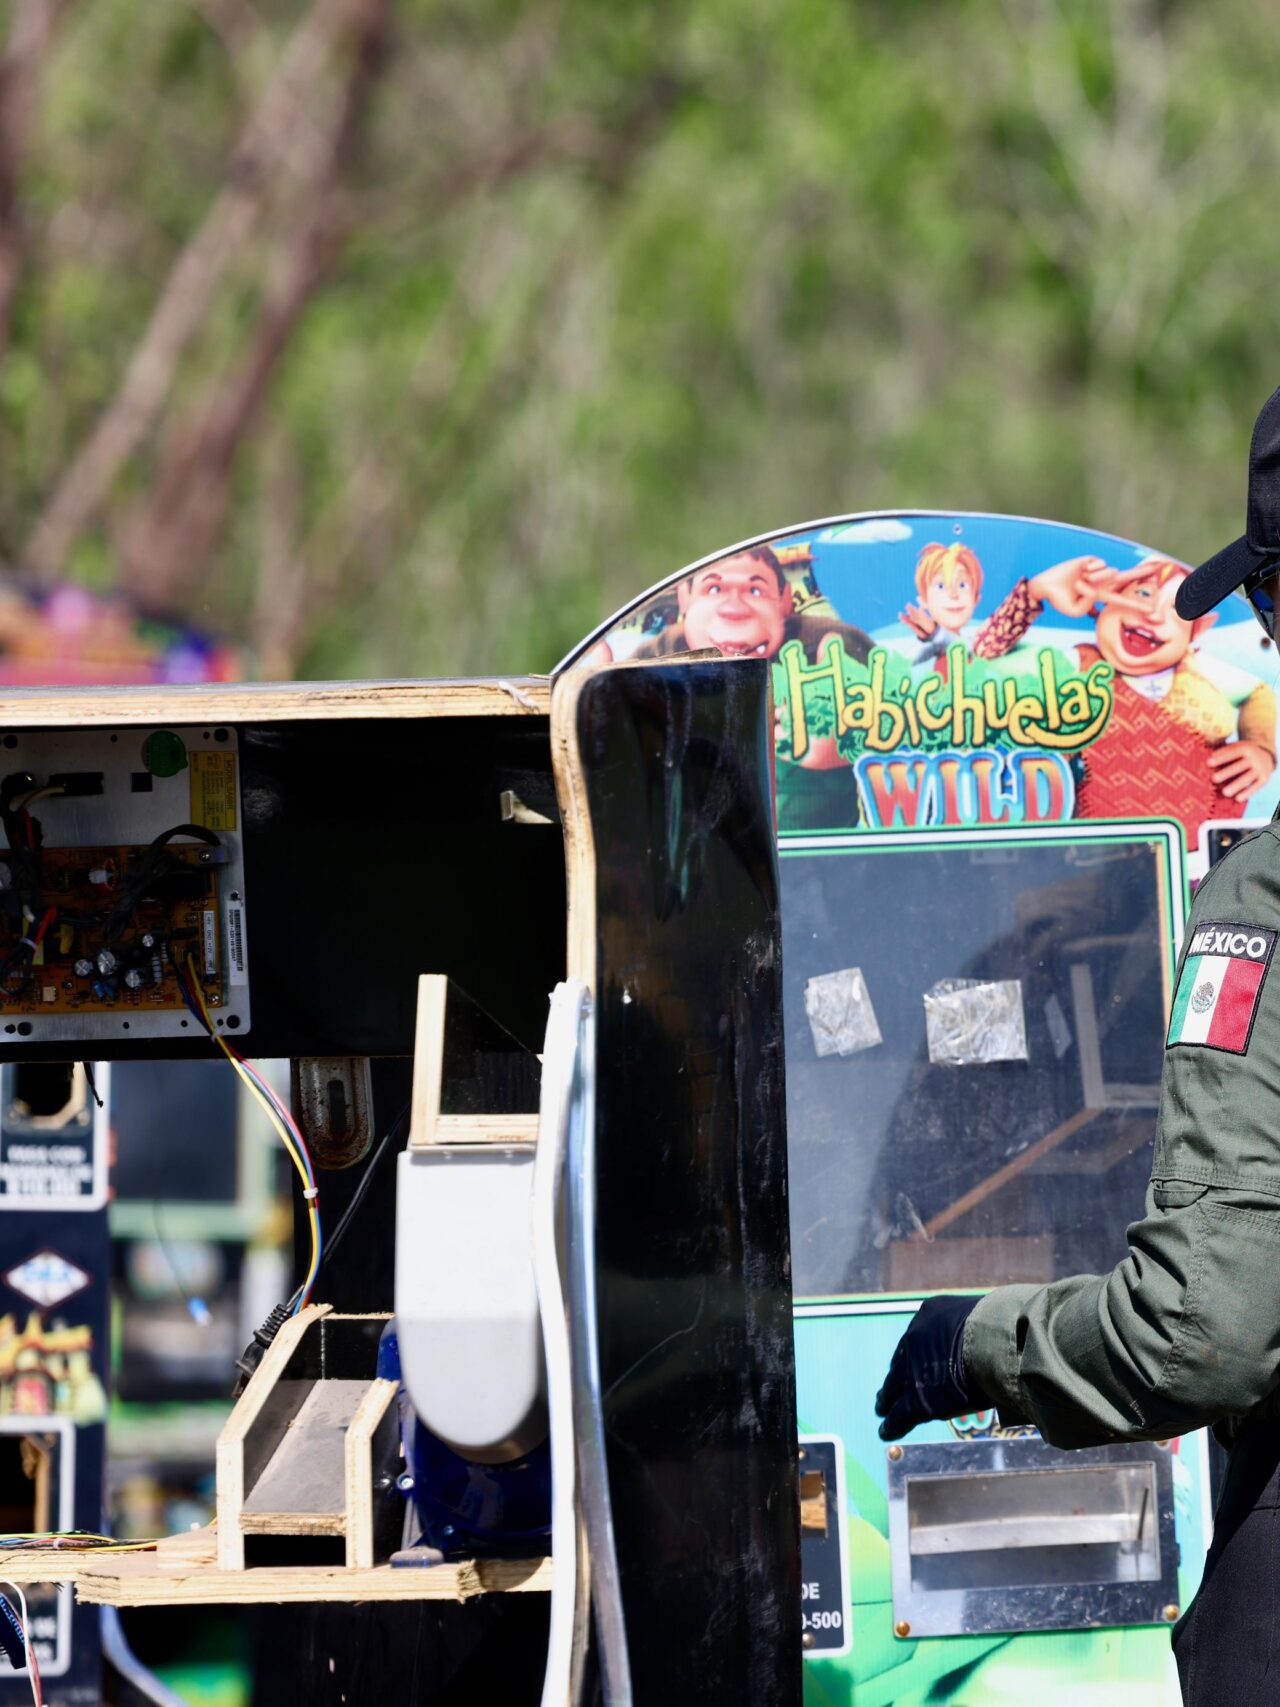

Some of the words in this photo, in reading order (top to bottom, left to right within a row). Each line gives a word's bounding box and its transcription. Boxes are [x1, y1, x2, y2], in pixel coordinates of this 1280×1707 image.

[783, 638, 1113, 760] Habichuelas
[857, 751, 1072, 828] WILD
[1189, 927, 1267, 958] MÉXICO
